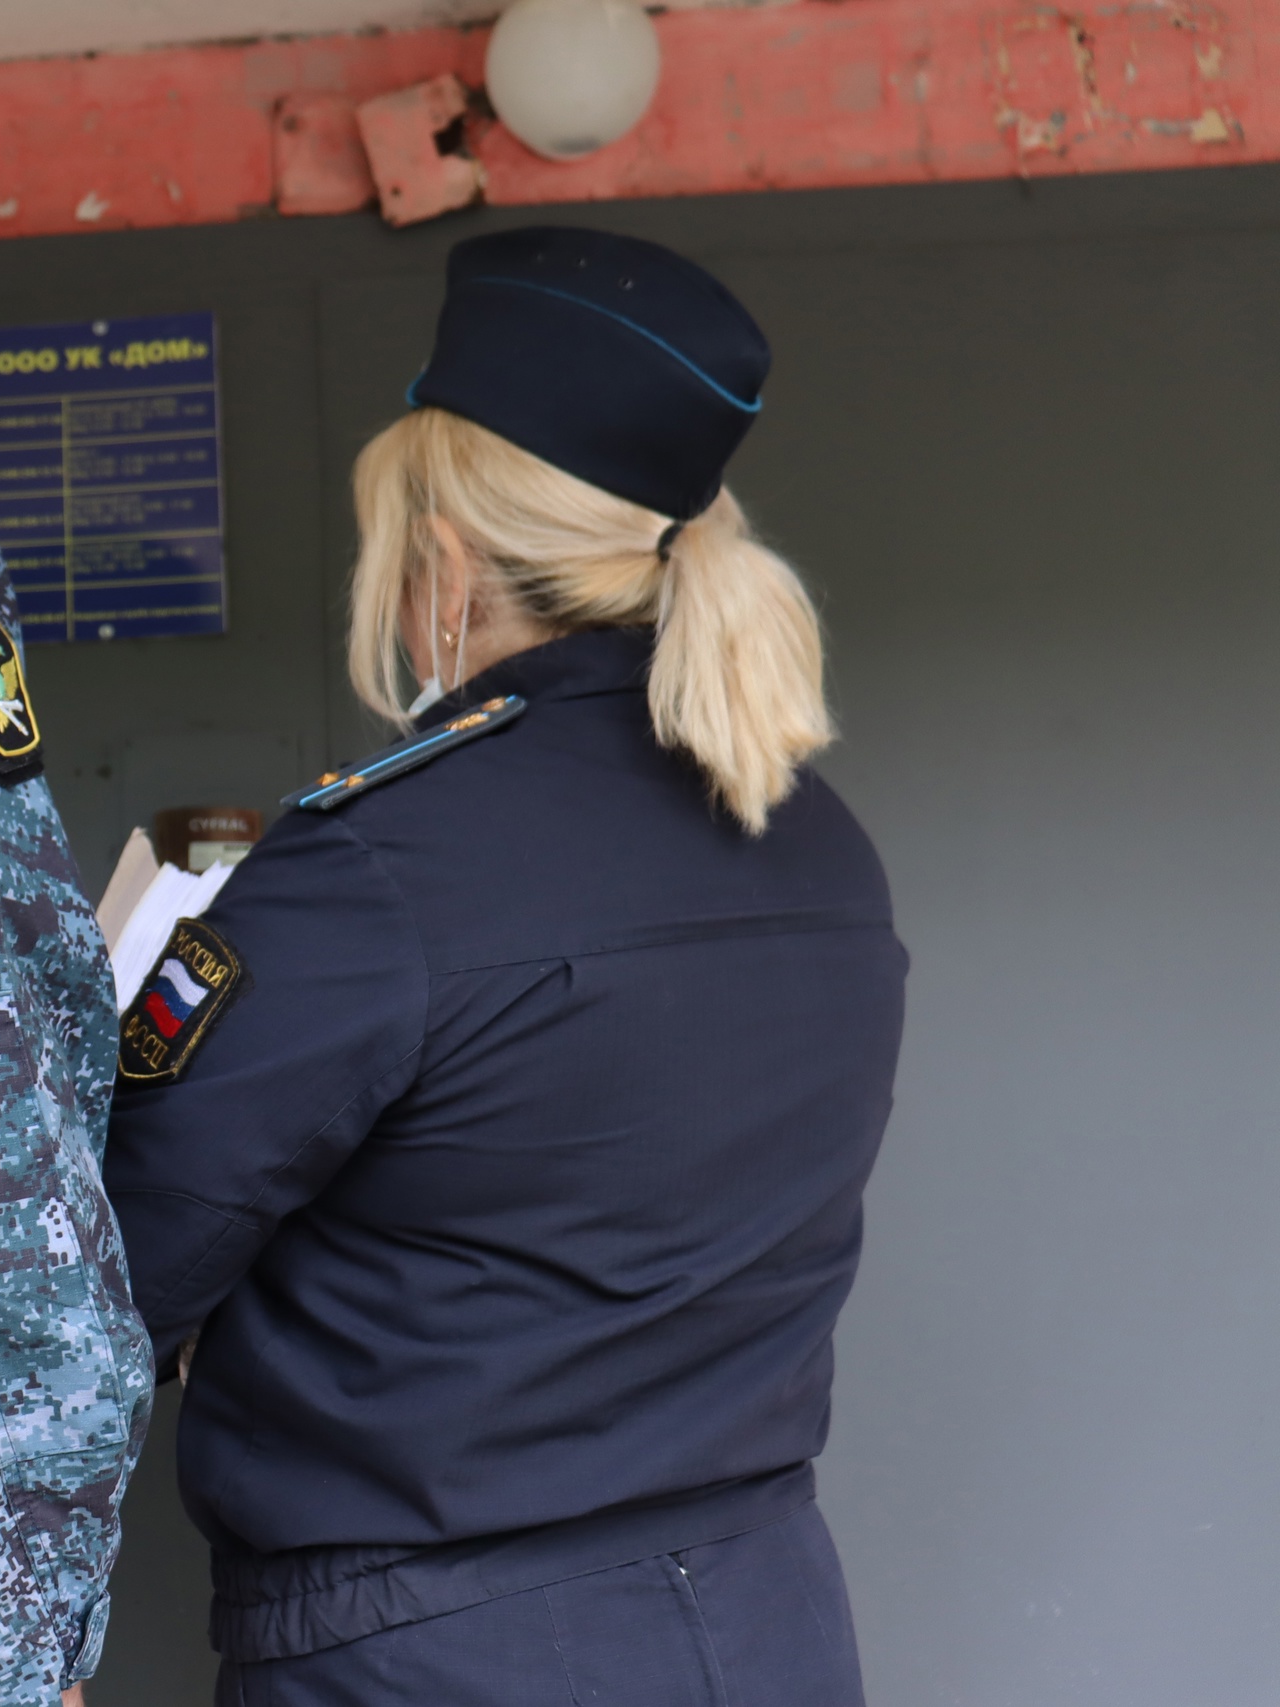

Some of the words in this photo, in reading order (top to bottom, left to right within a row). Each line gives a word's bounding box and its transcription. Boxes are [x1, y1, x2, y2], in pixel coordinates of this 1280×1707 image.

[66, 347, 101, 371] УК
[109, 339, 206, 369] «ДОМ»
[172, 927, 229, 990] РОССИЯ
[124, 1014, 169, 1070] ФССП
